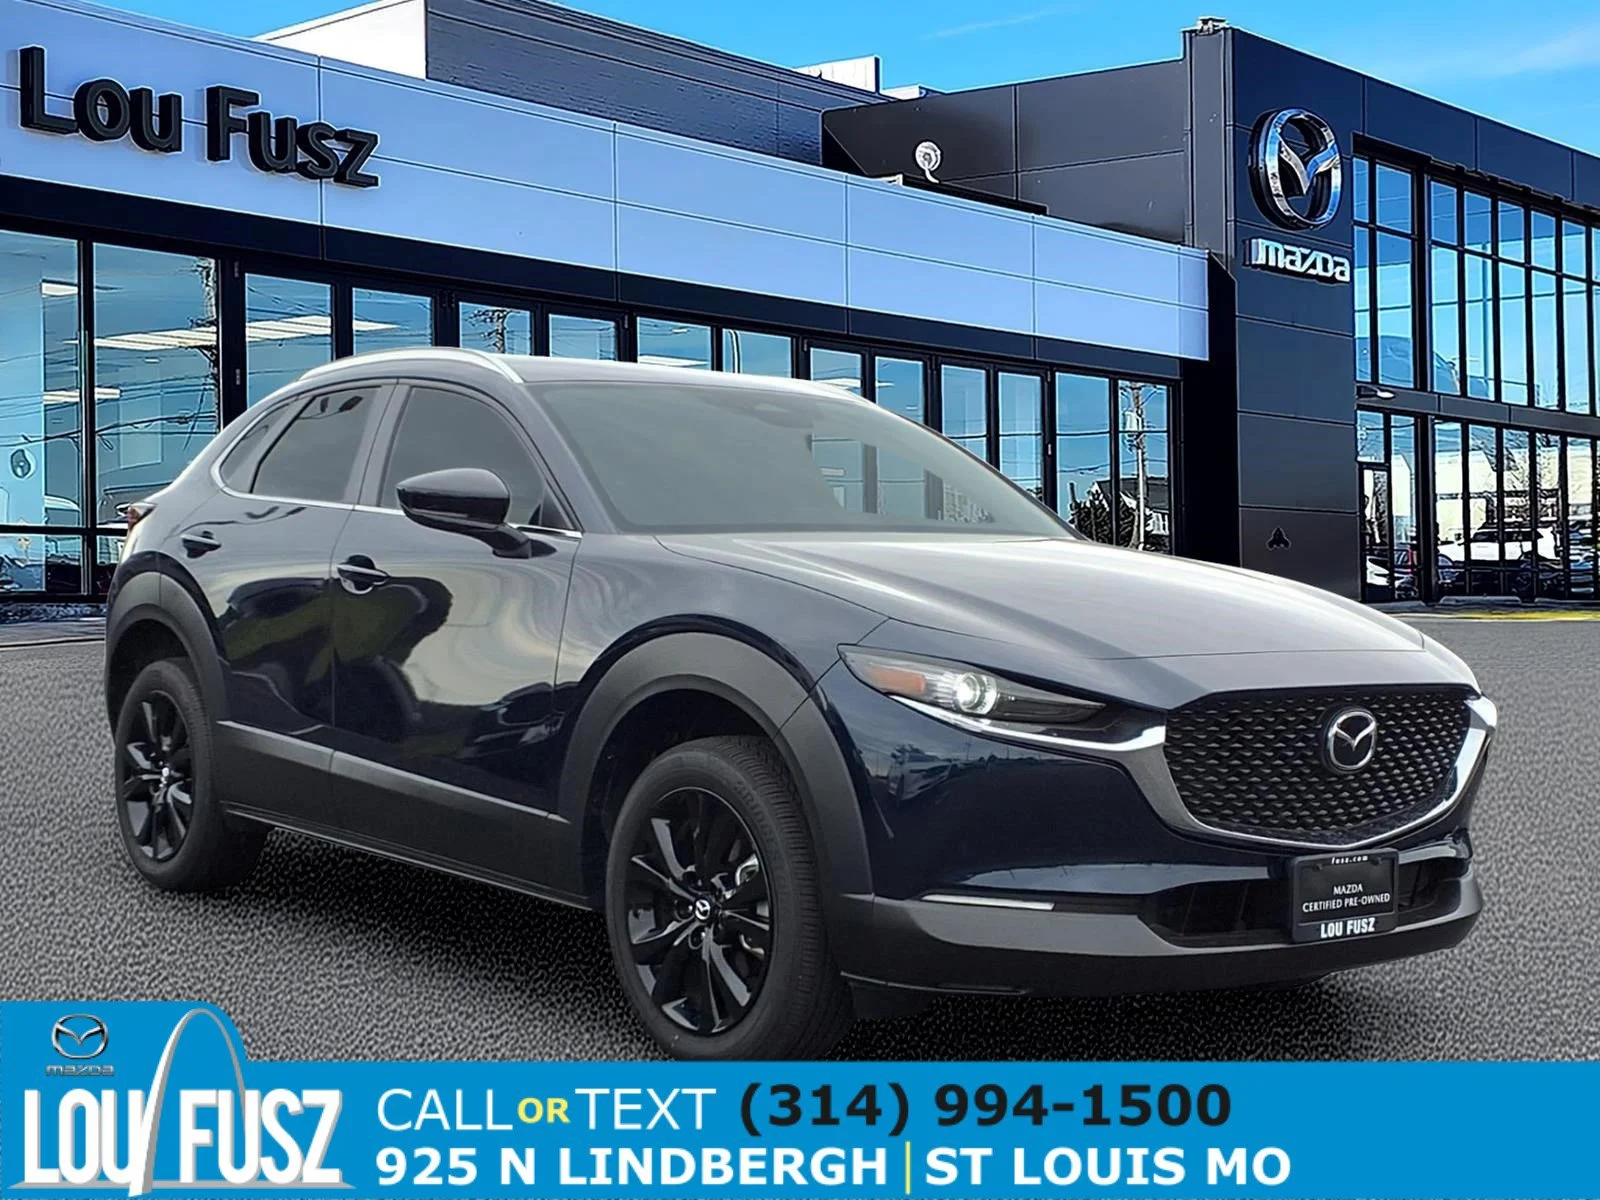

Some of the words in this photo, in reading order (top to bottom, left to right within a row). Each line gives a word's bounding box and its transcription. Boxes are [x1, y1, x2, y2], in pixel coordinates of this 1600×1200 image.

[19, 45, 182, 153] Lou
[206, 85, 379, 187] Fusz
[1333, 883, 1363, 896] MAZDA
[1302, 899, 1343, 913] CERTIFIED
[1344, 892, 1391, 908] PRE-OWNED
[1320, 921, 1344, 939] LOU
[1346, 917, 1375, 935] FUSZ
